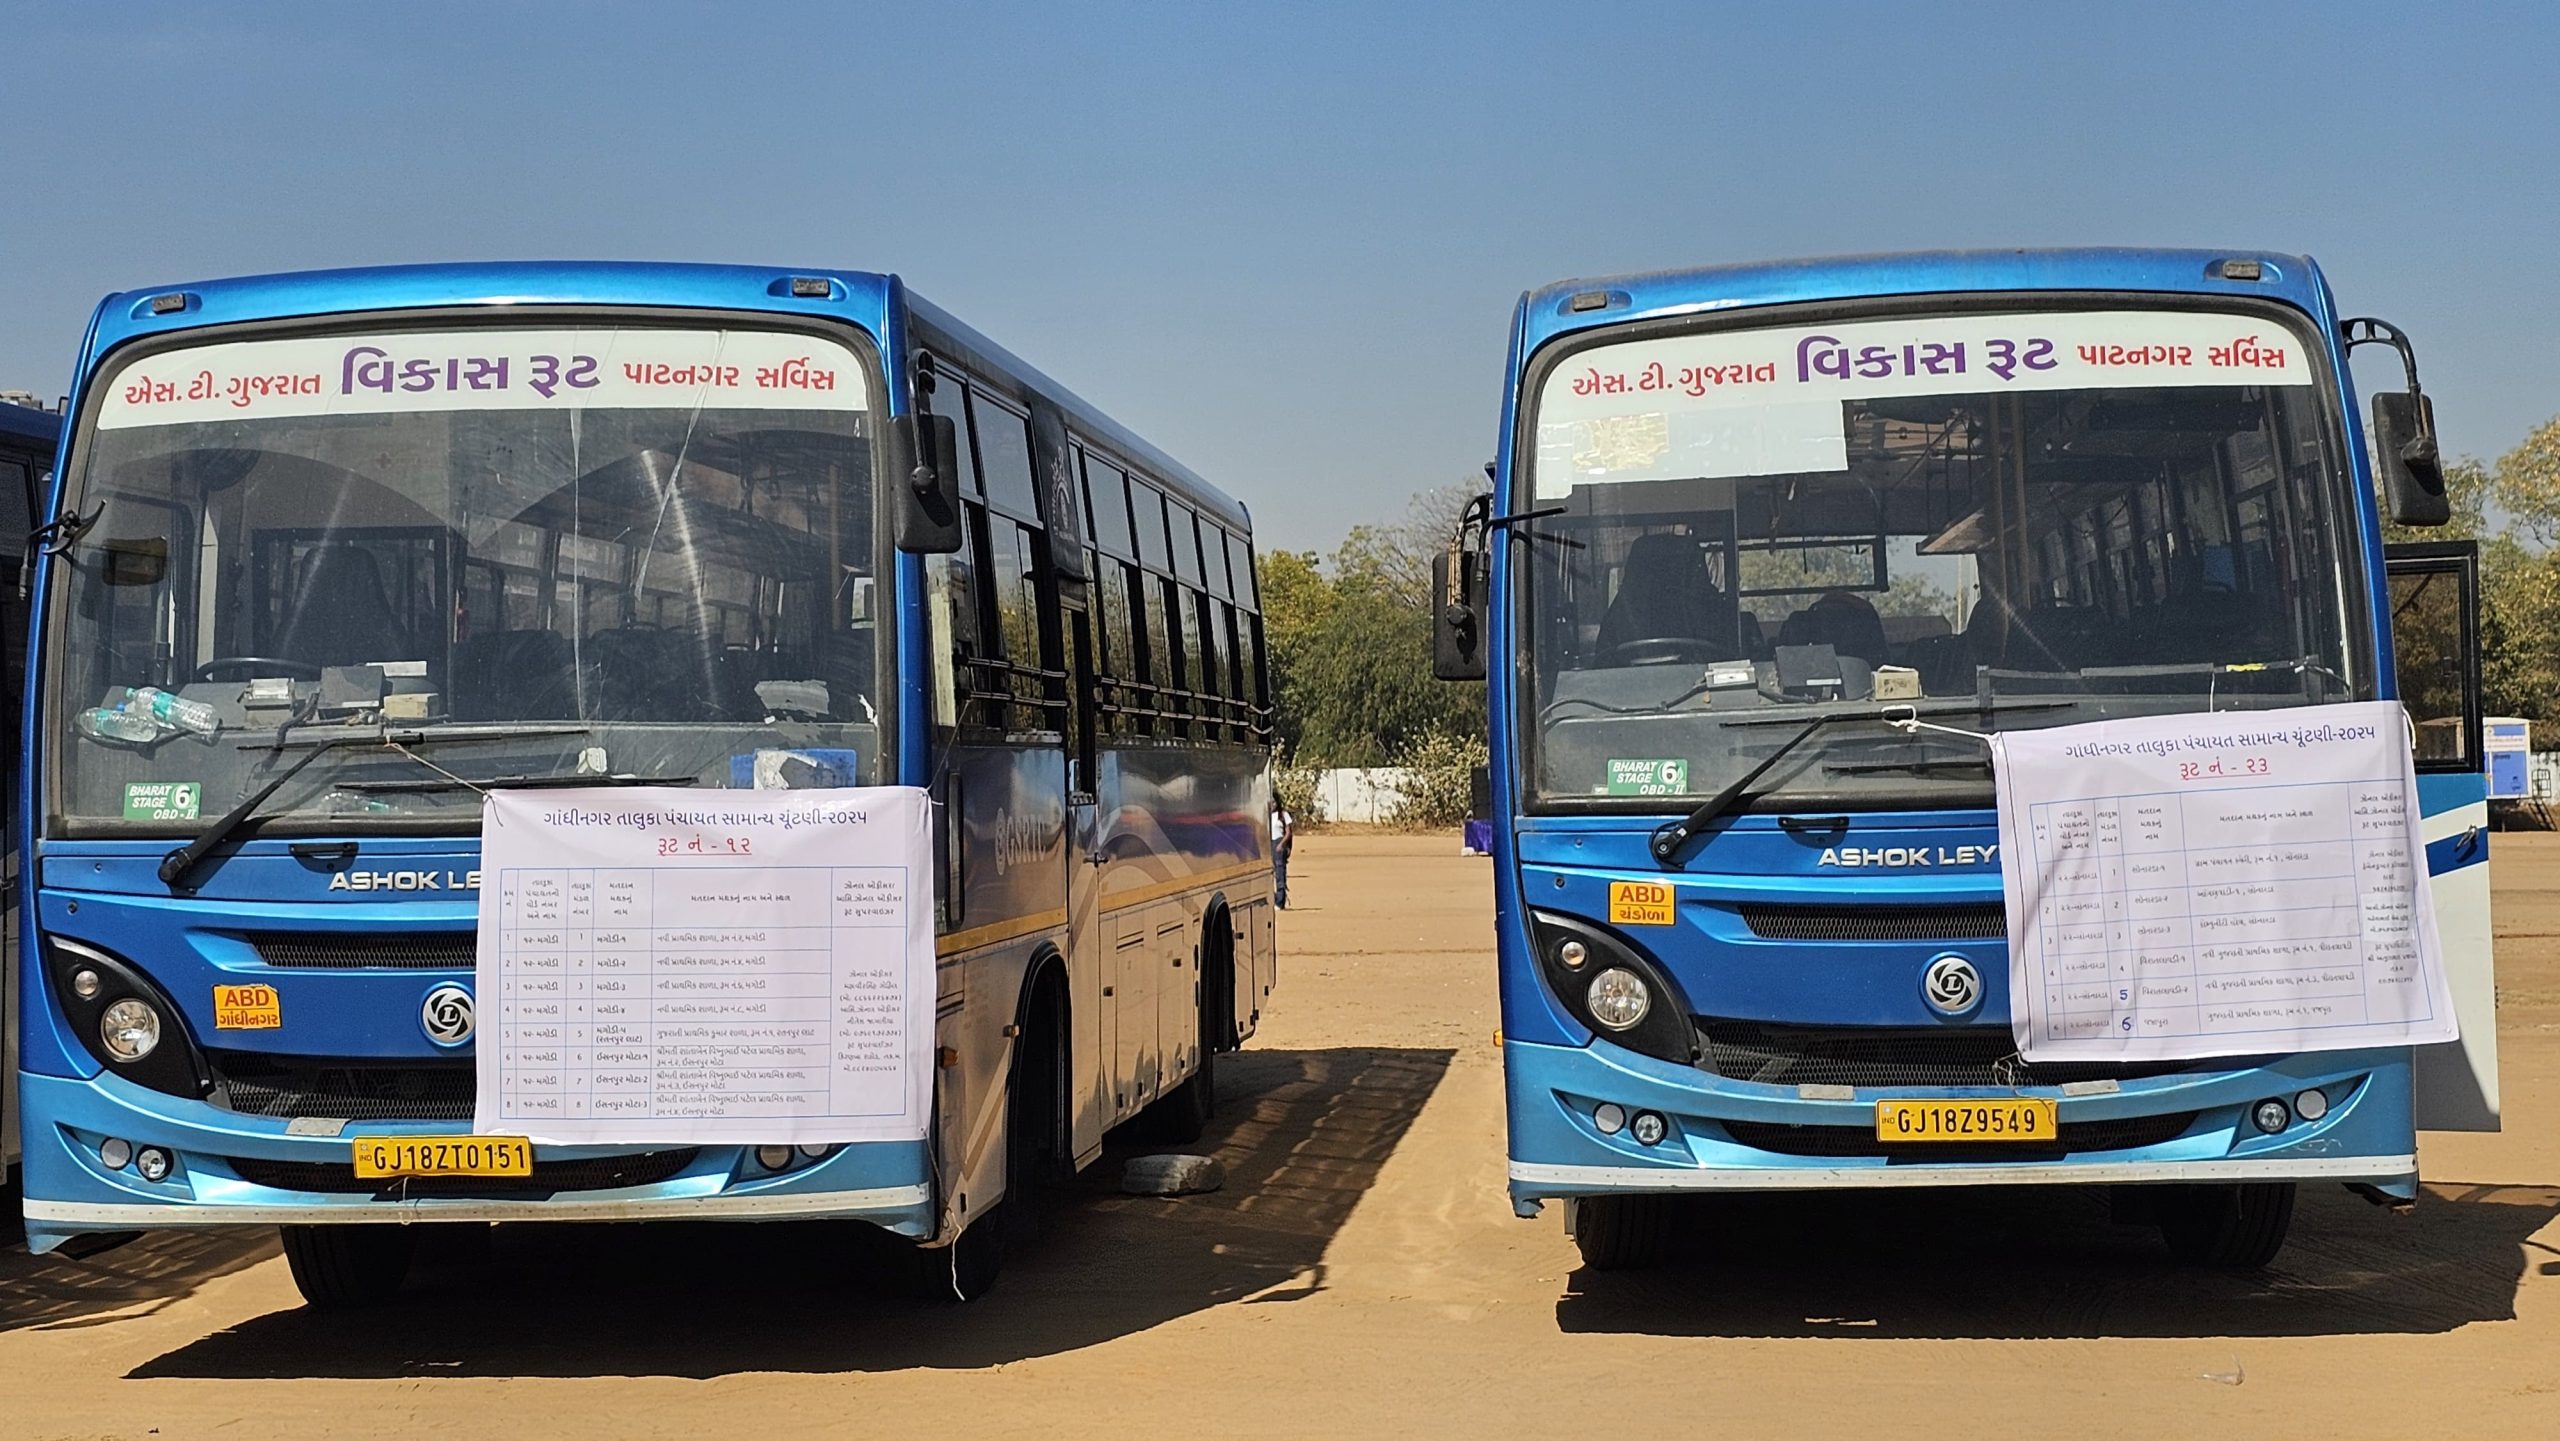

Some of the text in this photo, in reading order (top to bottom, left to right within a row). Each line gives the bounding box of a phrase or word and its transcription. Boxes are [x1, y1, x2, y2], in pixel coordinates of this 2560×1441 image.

[1796, 335, 1966, 382] વિકાસ
[1986, 338, 2058, 381] રૂટ
[2077, 343, 2192, 367] પાટનગર
[2207, 335, 2285, 369] સર્વિસ
[341, 346, 509, 395] વિકાસ
[528, 354, 601, 399] રૂટ
[623, 363, 740, 387] પાટનગર
[755, 357, 836, 390] સર્વિસ
[2065, 741, 2132, 759] ગાંધીનગર
[2136, 738, 2180, 757] તાલુકા
[2184, 735, 2234, 752] પંચાયત
[2239, 732, 2288, 749] સામાન્ય
[1612, 761, 1658, 773] BHARAT
[1661, 761, 1677, 784] 6
[2180, 763, 2200, 780] રૂટ
[2209, 756, 2224, 775] નં
[1616, 773, 1653, 783] STAGE
[129, 785, 172, 797] BHARAT
[175, 784, 191, 808] 6
[132, 797, 167, 808] STAGE
[544, 809, 612, 826] ગાંધીનગર
[617, 811, 662, 830] તાલુકા
[665, 810, 717, 826] પંચાયત
[722, 811, 774, 826] સામાન્ય
[658, 838, 678, 854] રૂટ
[688, 833, 702, 853] નં
[1818, 847, 1931, 867] ASHOK
[328, 871, 440, 890] ASHOK
[1619, 885, 1666, 903] ABD
[224, 989, 270, 1007] ABD
[1897, 1108, 2036, 1134] GJ18Z9549
[373, 1143, 526, 1172] GJ18ZT0151
